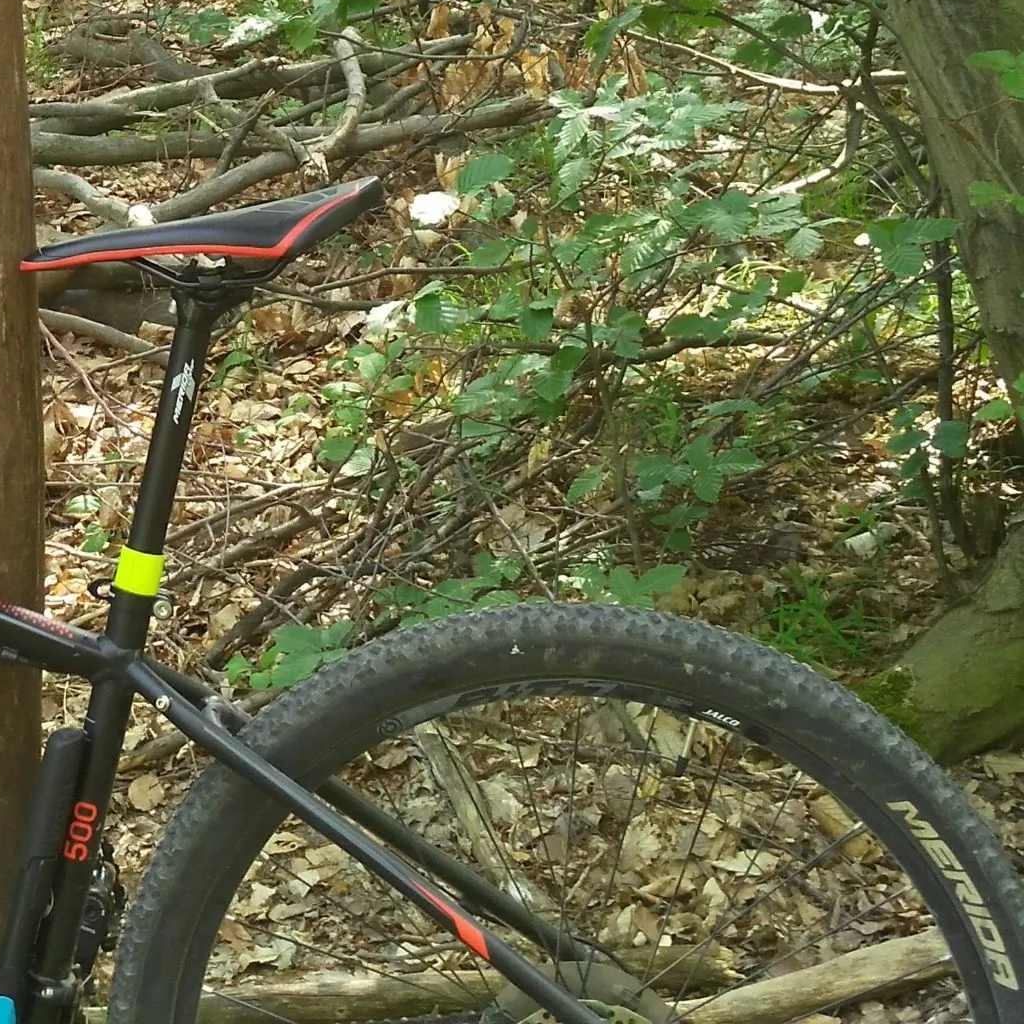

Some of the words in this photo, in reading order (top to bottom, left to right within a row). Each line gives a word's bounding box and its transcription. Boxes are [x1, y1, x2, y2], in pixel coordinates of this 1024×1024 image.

[702, 708, 741, 727] JALCO
[63, 801, 98, 863] 500
[886, 800, 1020, 992] MERIDA
